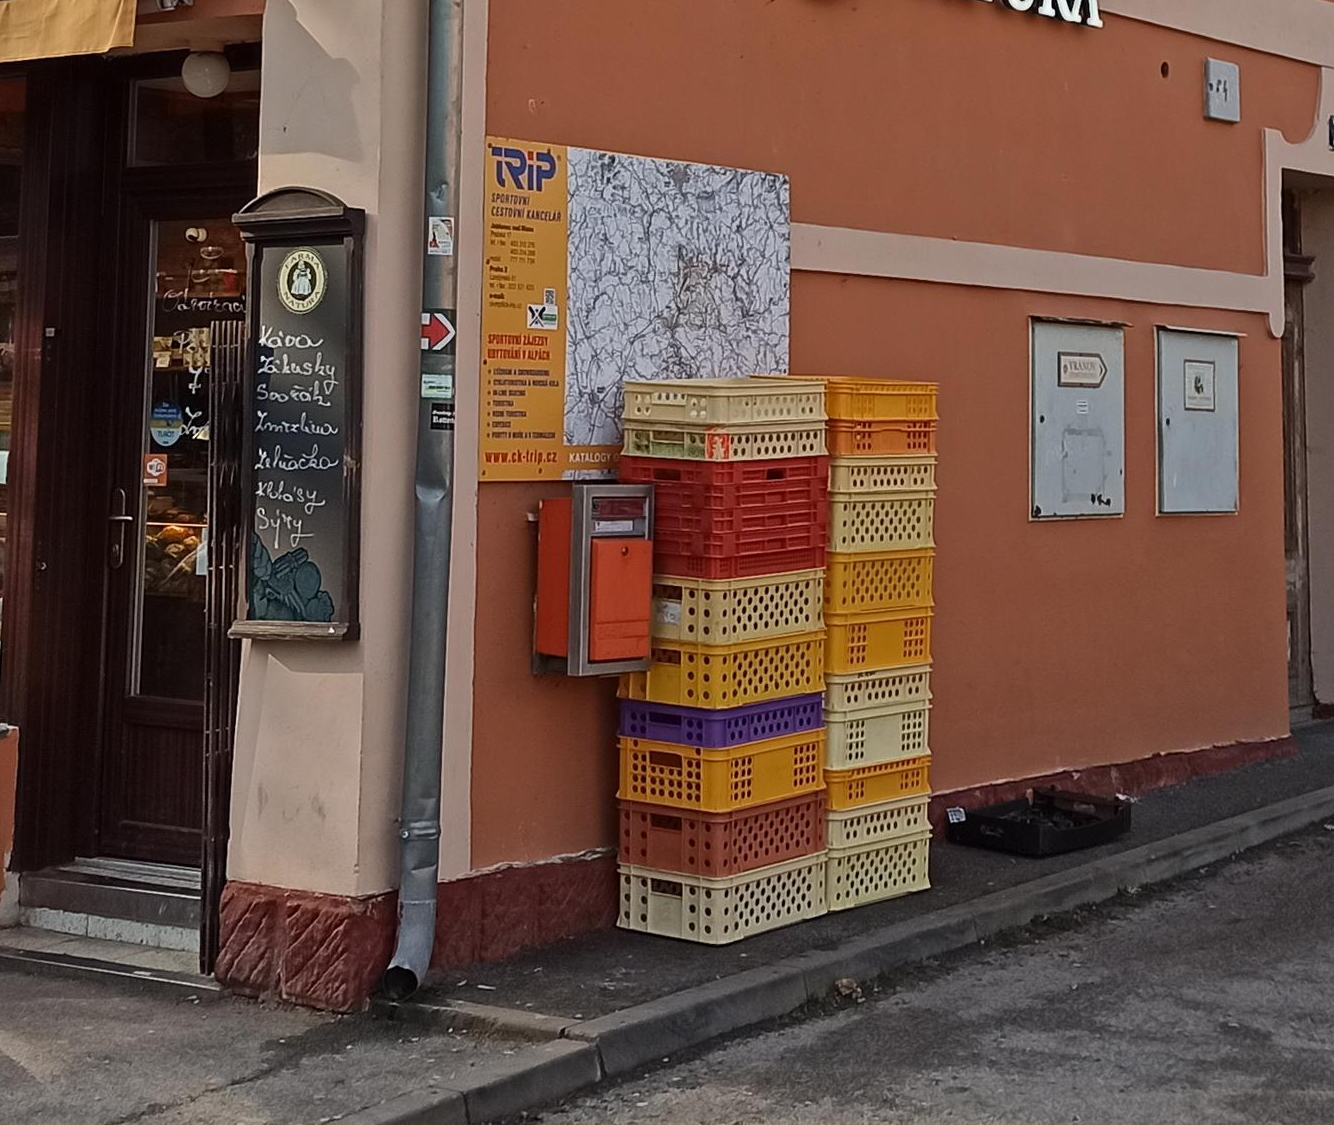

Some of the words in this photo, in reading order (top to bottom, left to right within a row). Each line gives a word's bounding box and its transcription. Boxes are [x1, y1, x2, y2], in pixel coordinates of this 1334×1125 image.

[491, 193, 530, 205] SPORTOVNÍ
[491, 206, 525, 218] CESTOVNÍ
[257, 351, 339, 395] Zákusky
[485, 449, 557, 465] www.ck-trip.cz
[569, 452, 611, 463] KATALOGY
[256, 507, 315, 550] Sýry
